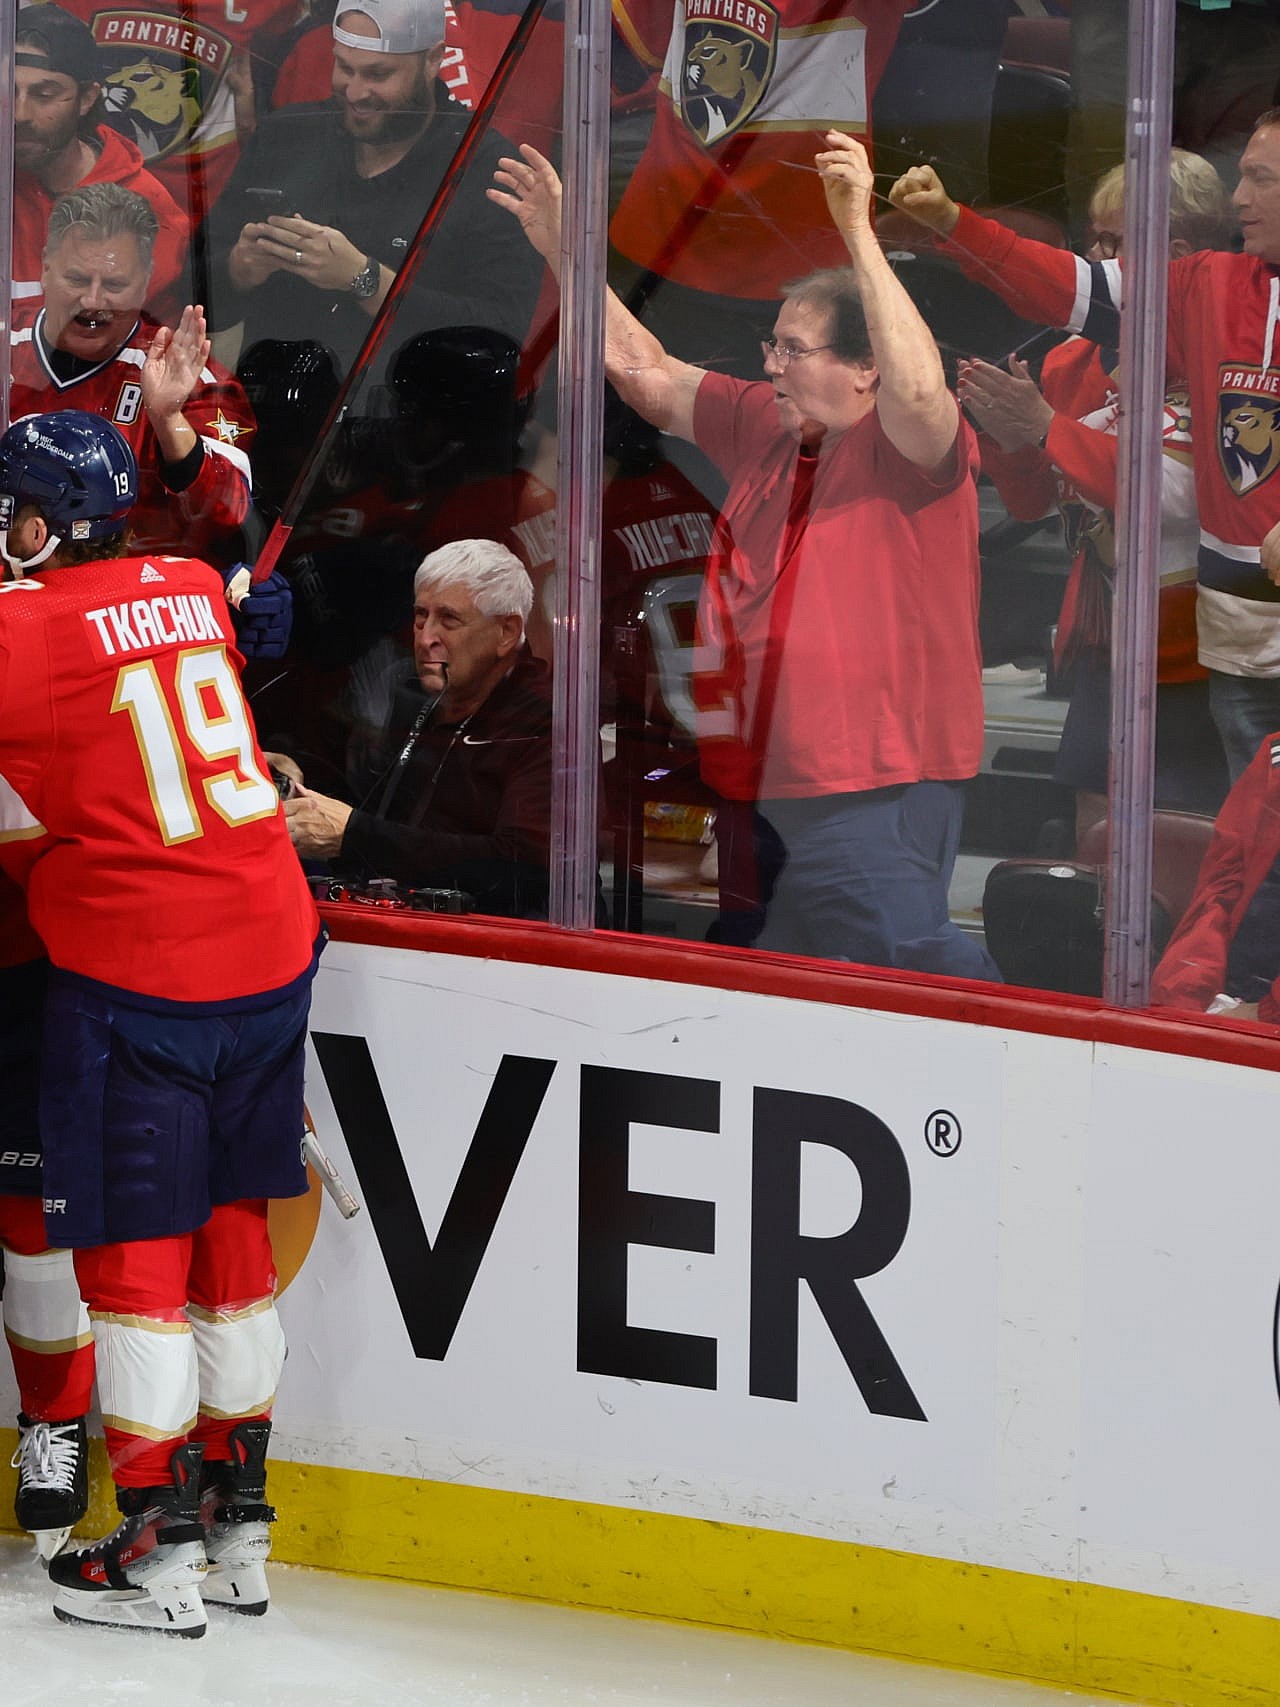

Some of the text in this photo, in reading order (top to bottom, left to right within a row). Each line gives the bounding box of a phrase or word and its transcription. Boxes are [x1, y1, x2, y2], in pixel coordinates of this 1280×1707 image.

[687, 0, 767, 34] PANTHERS
[104, 20, 218, 63] PANTHERS
[36, 440, 75, 462] LAUDERDALE
[114, 472, 129, 496] 19
[85, 594, 224, 656] TKACHUK
[110, 643, 279, 847] 19
